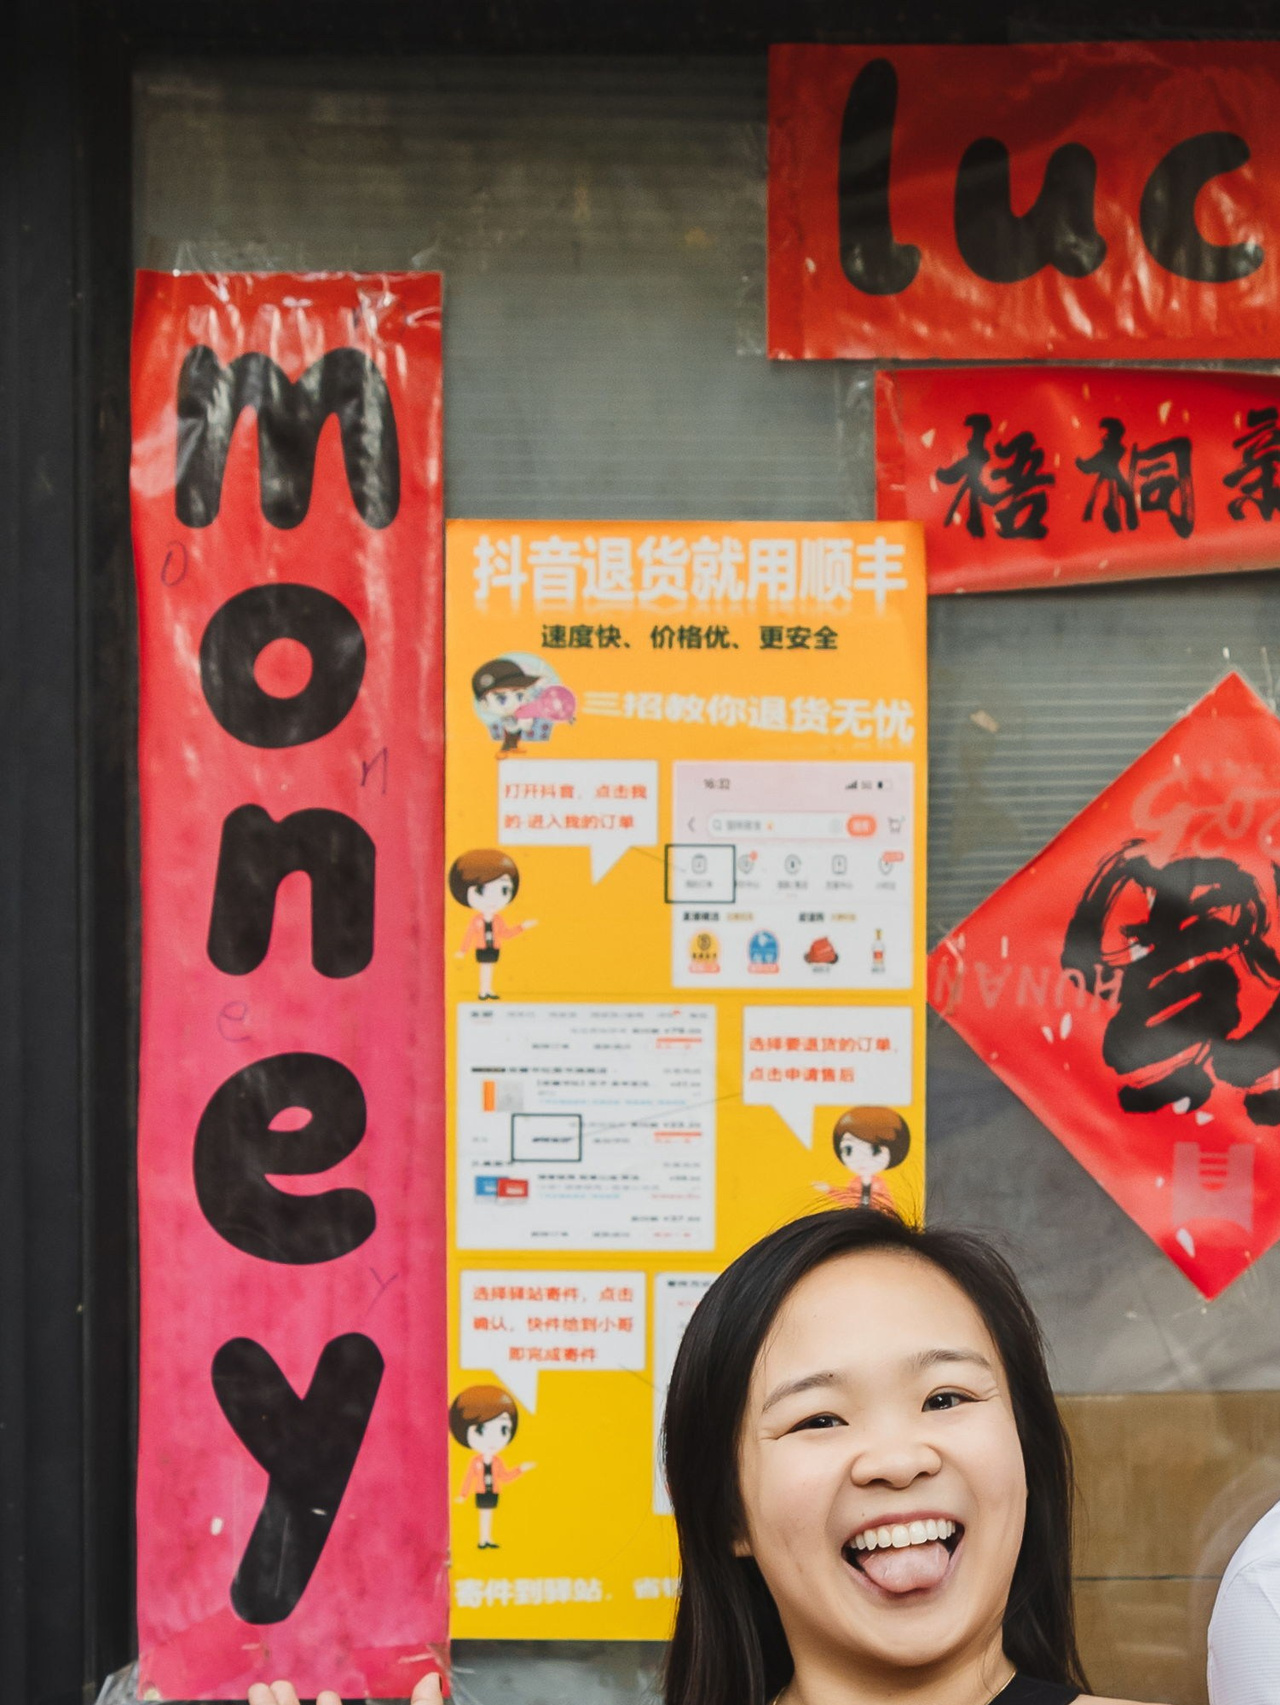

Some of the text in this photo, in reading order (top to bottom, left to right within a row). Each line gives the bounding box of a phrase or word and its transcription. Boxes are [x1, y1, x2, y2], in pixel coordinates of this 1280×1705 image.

[473, 535, 908, 604] 抖音退货就用顺丰
[541, 624, 839, 650] 速度快、价格优、更安全
[582, 690, 915, 745] 三招教你退货无忧
